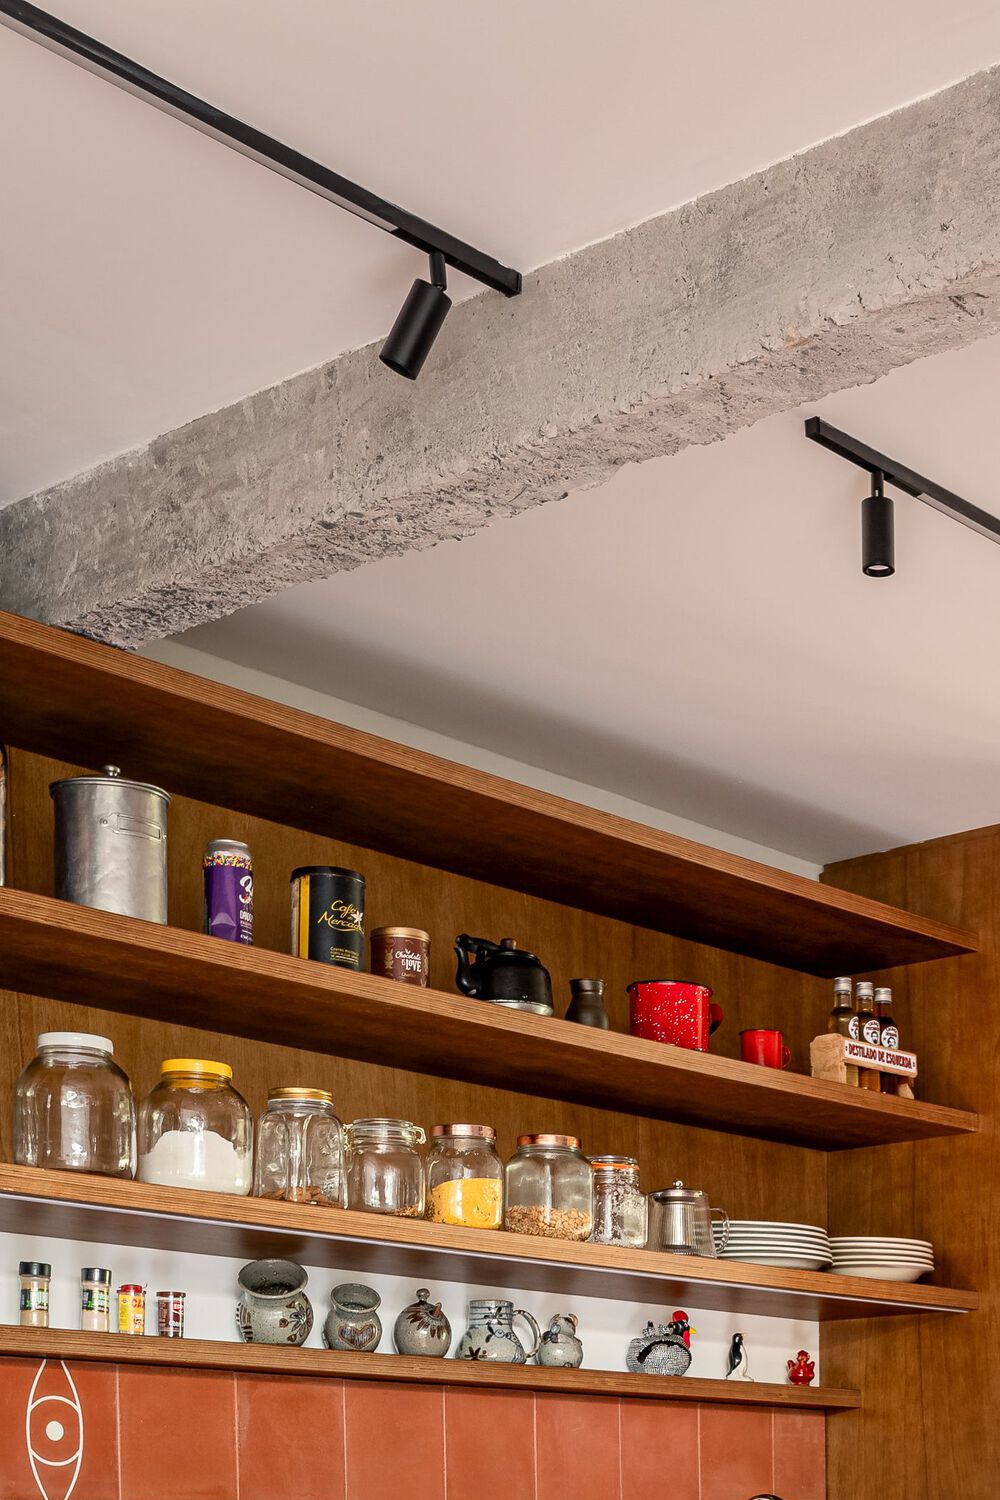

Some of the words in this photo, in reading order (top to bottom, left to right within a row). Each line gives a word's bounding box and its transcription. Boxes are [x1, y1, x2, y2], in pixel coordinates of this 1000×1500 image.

[405, 959, 422, 973] LOVE
[849, 1043, 877, 1060] DESTILADO
[878, 1050, 885, 1063] DE
[886, 1052, 912, 1069] ESQUERDA
